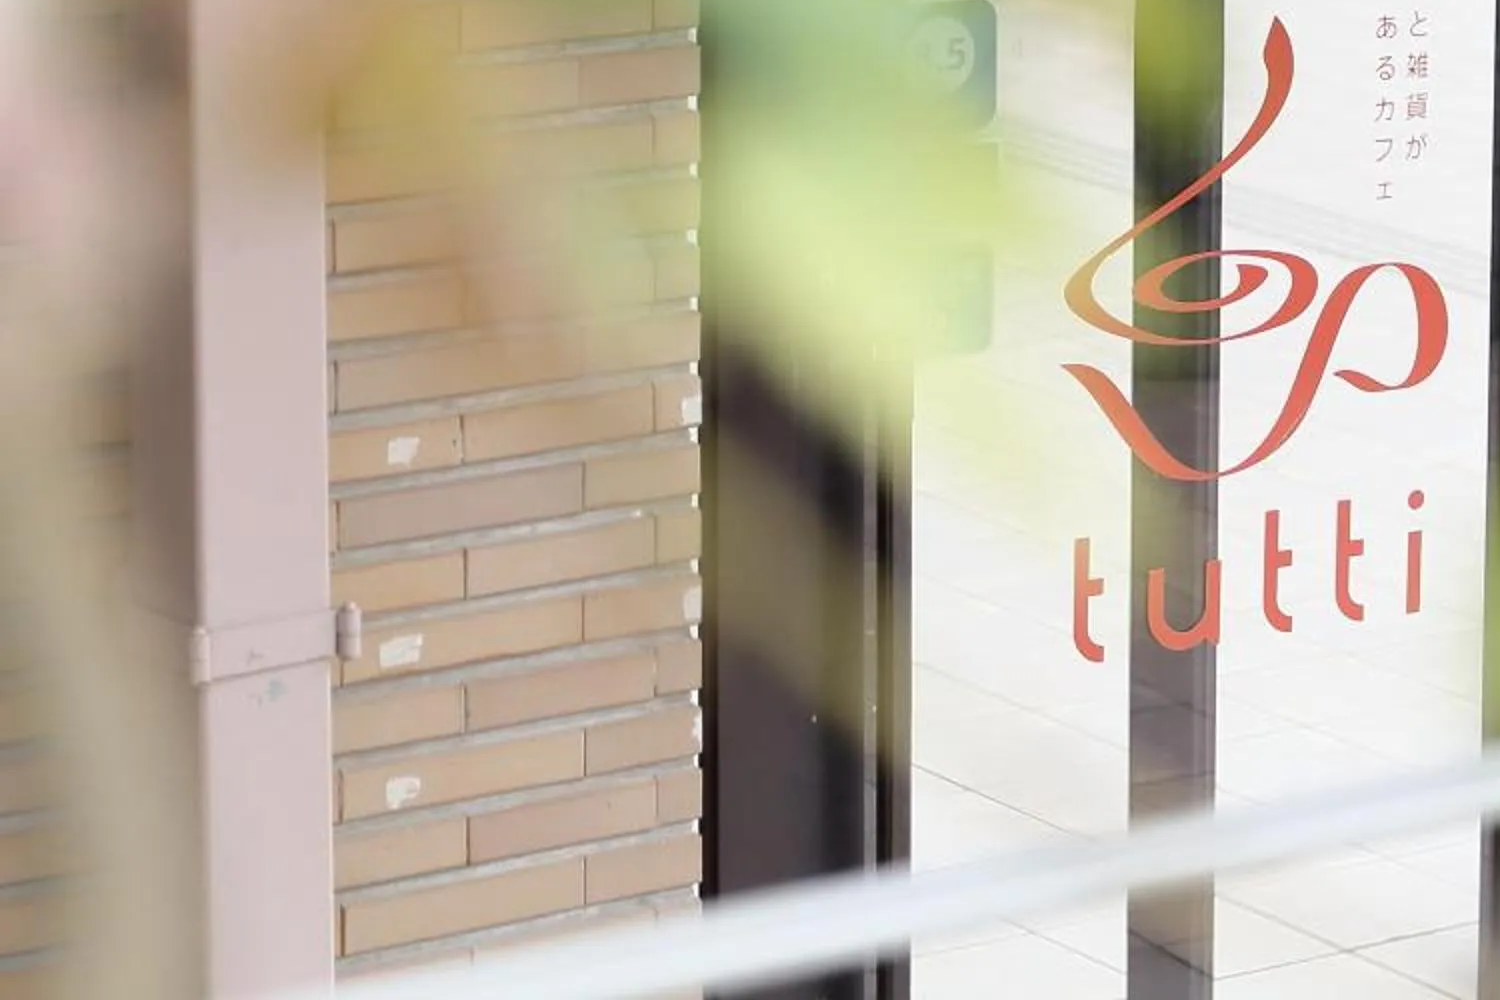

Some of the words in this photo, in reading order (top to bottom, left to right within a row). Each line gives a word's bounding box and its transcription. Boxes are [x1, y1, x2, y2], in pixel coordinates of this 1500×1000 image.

[1374, 14, 1398, 200] あるカフェ
[1074, 490, 1425, 662] tutti
